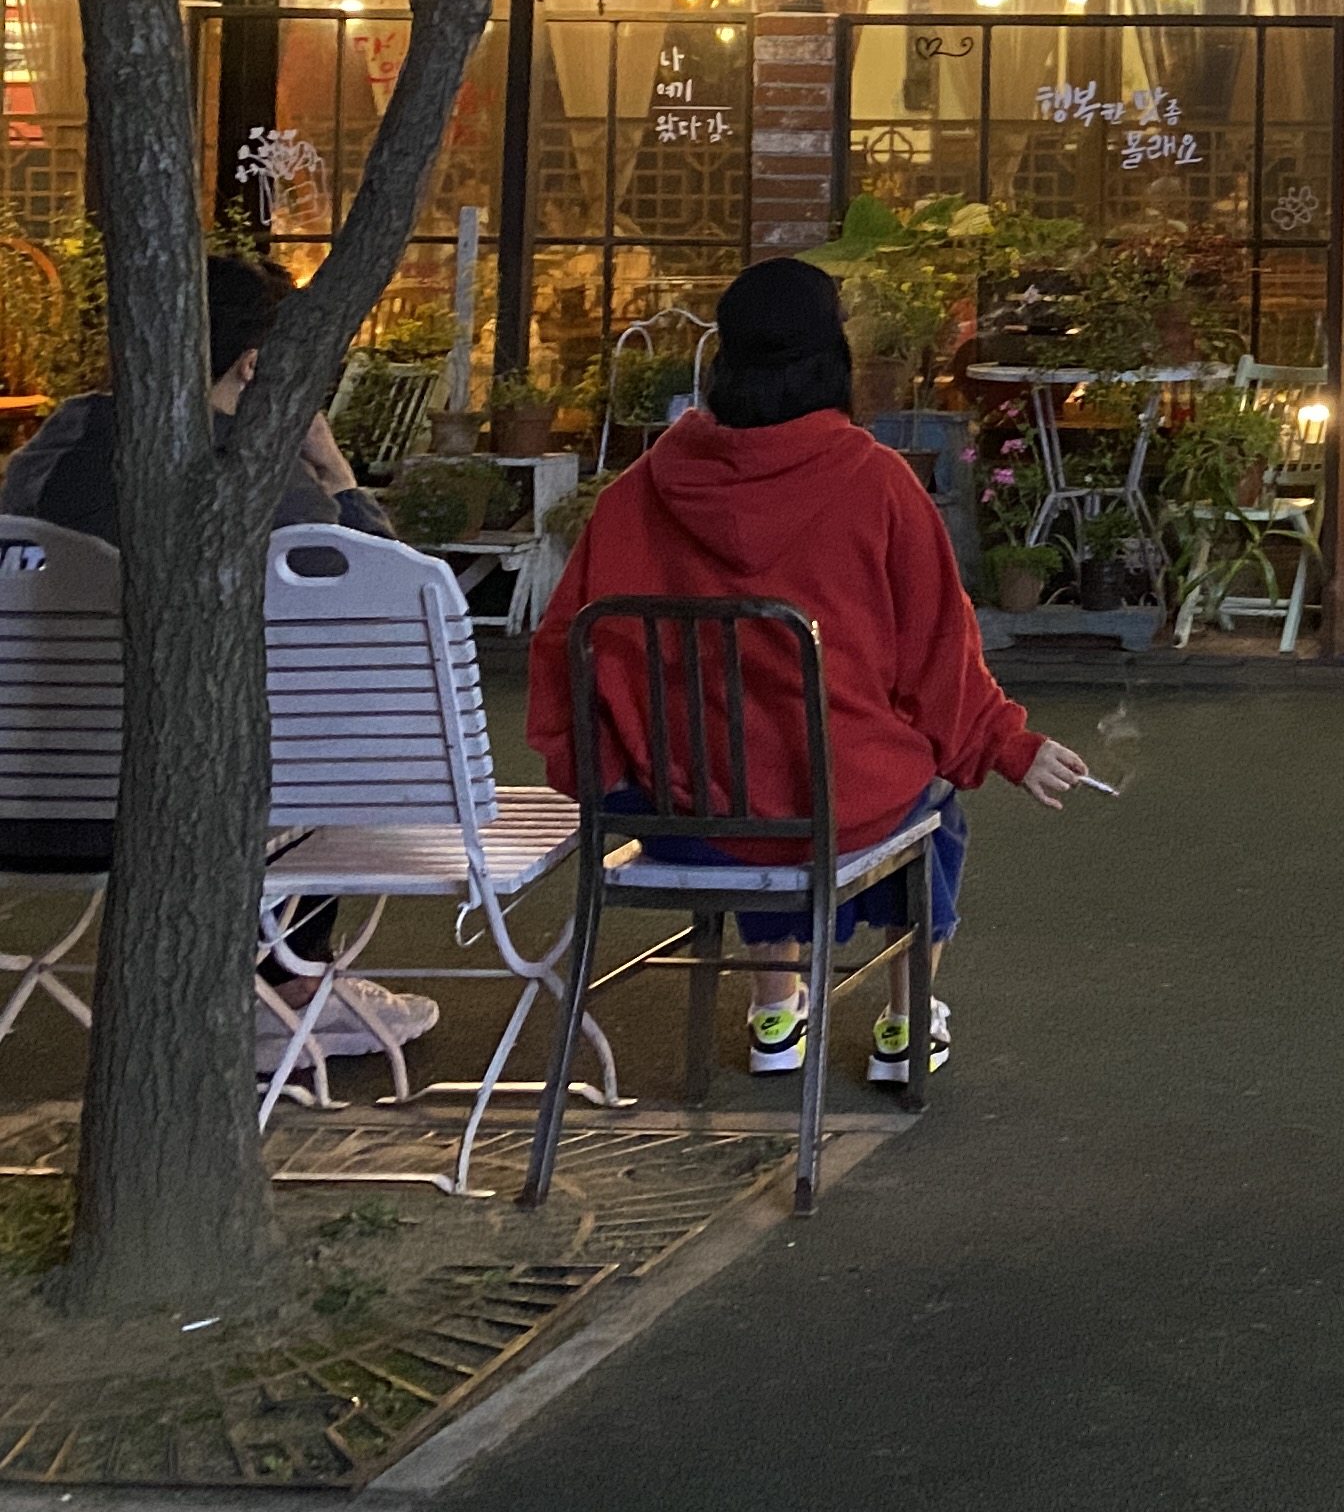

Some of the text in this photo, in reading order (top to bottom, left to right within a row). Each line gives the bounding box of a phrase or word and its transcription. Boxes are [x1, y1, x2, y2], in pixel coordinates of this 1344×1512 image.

[660, 45, 686, 72] 나
[655, 78, 693, 103] 여기
[1034, 79, 1127, 128] 행복한
